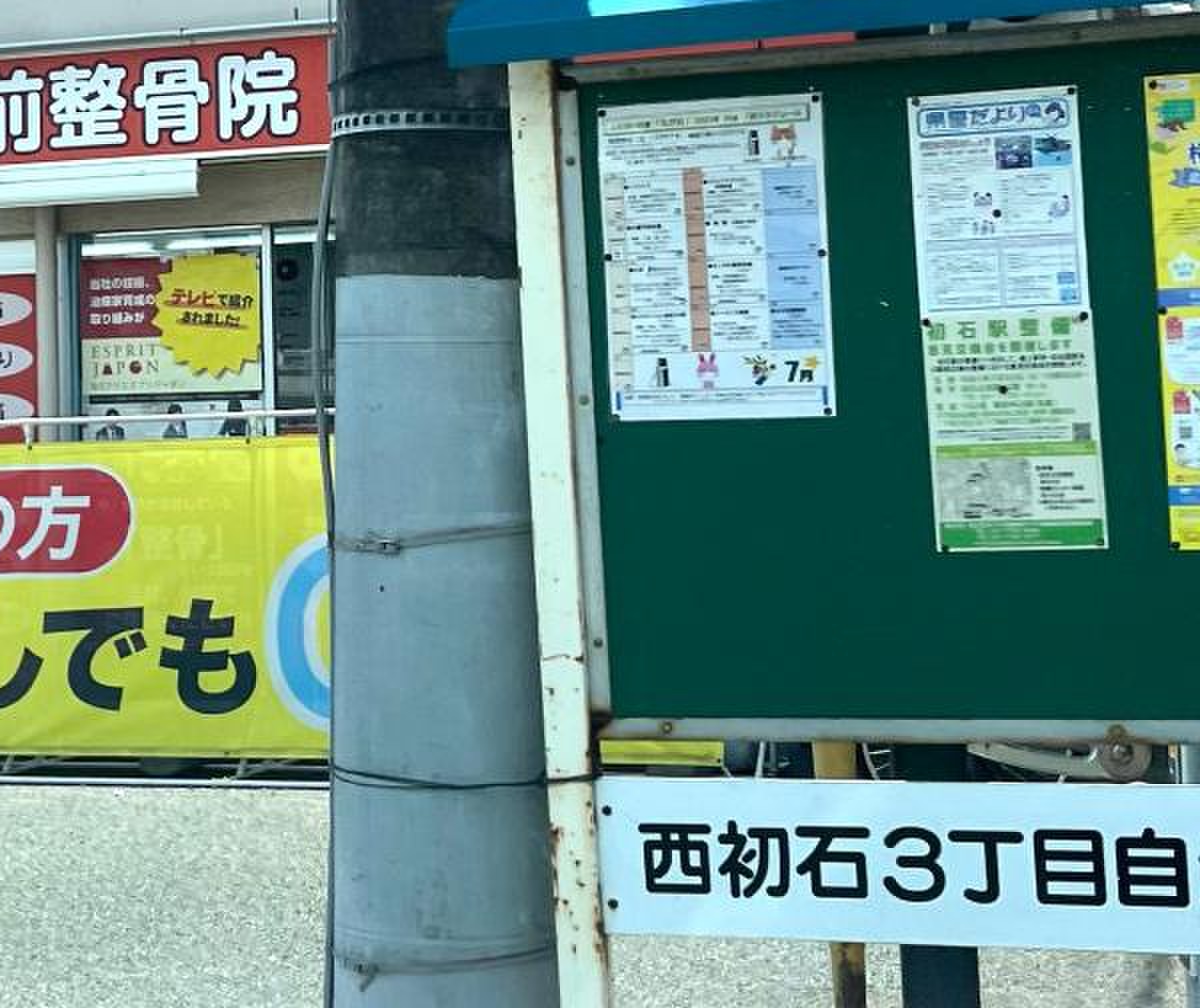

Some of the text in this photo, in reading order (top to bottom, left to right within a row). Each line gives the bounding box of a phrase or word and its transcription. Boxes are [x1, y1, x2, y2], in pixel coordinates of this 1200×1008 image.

[91, 344, 158, 359] ESPRIT
[783, 359, 814, 383] 7月
[638, 819, 1190, 907] 西初石3丁目自
